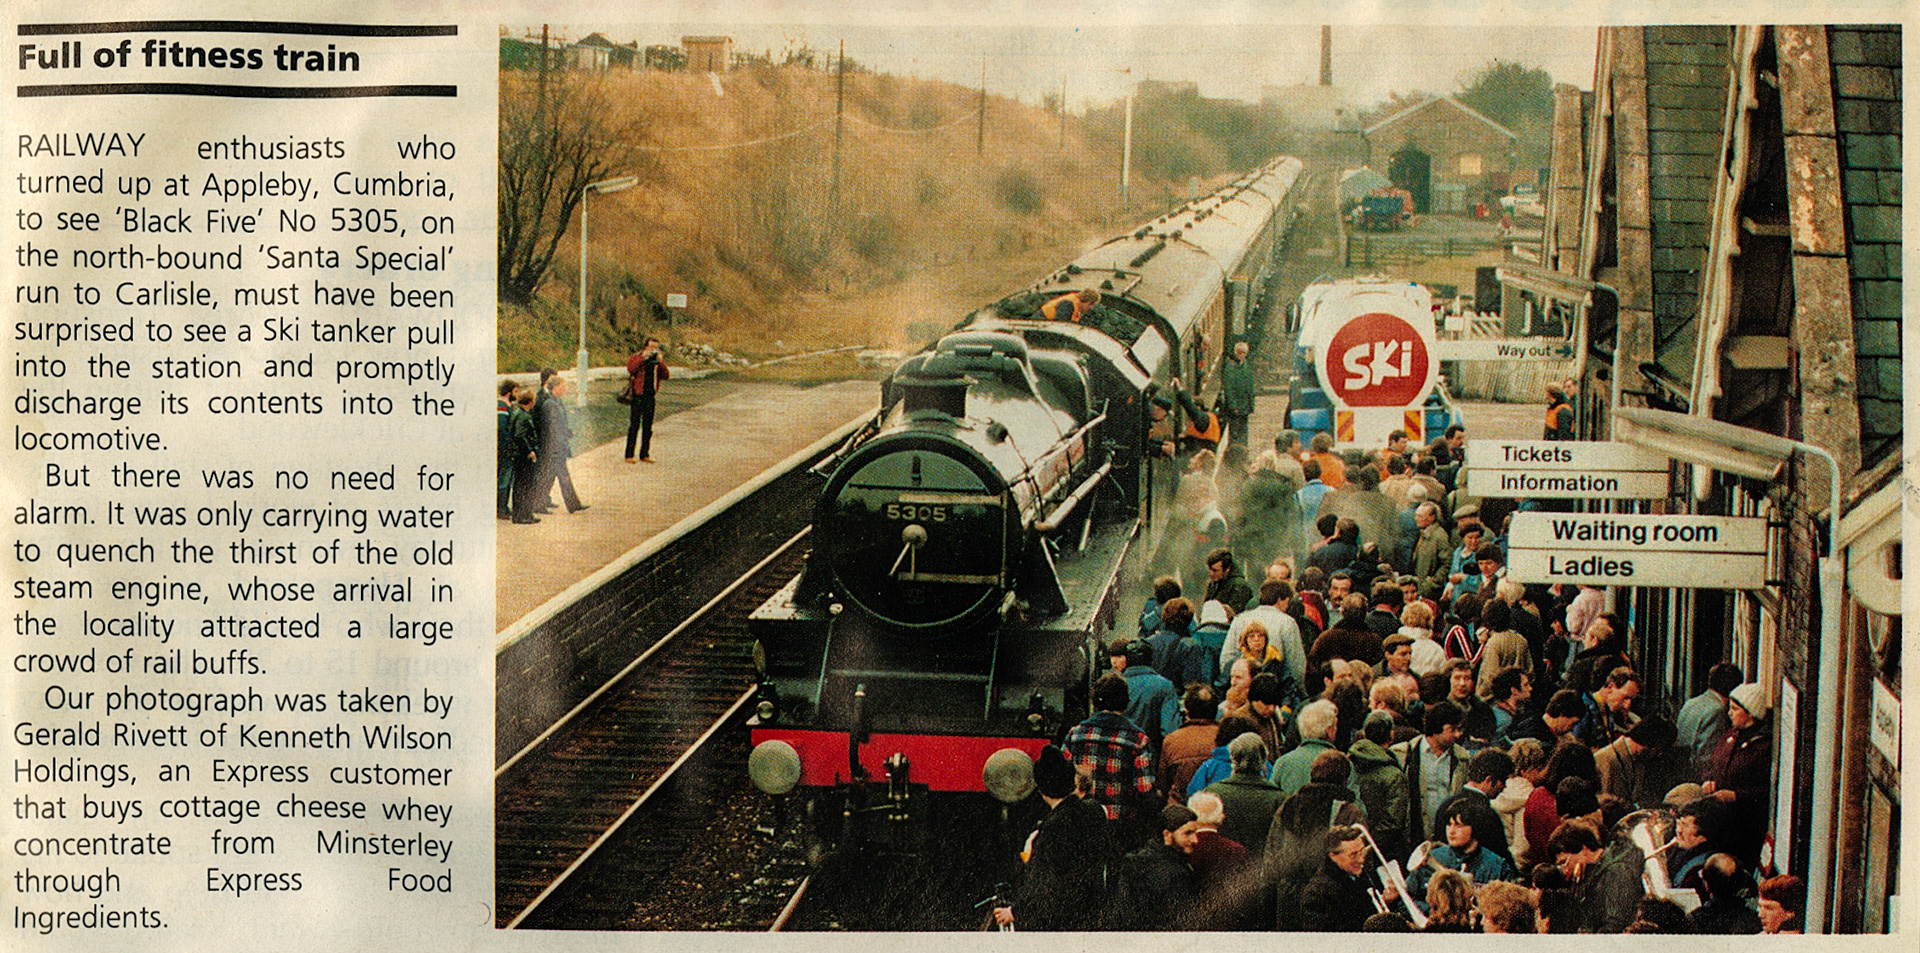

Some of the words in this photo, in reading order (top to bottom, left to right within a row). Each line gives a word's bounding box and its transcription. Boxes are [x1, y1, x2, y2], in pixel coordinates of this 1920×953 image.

[19, 41, 81, 69] Full
[94, 40, 131, 68] of
[142, 40, 263, 69] fitness
[274, 44, 359, 71] train
[19, 133, 145, 157] RAILWAY
[198, 135, 344, 159] enthusiasts
[398, 134, 455, 160] who
[17, 168, 103, 194] turned
[119, 177, 150, 201] up
[165, 174, 189, 196] at
[202, 171, 318, 202] Appleby,
[334, 171, 453, 201] Cumbria,
[17, 210, 42, 230] to
[58, 212, 99, 231] see
[116, 207, 192, 232] 'Black
[208, 208, 262, 233] Five'
[281, 209, 315, 232] No
[332, 208, 405, 237] 5305,
[422, 216, 453, 234] on
[16, 242, 58, 266] the
[74, 244, 241, 269] north-bound
[259, 245, 339, 269] 'Santa
[356, 246, 453, 276] Special'
[17, 286, 58, 303] run
[74, 283, 100, 305] to
[117, 281, 217, 309] Carlisle,
[235, 284, 299, 305] must
[315, 280, 374, 306] have
[391, 282, 453, 308] been
[15, 317, 133, 347] surprised
[146, 320, 172, 341] to
[184, 325, 226, 342] see
[238, 325, 250, 341] a
[264, 317, 299, 341] Ski
[311, 318, 396, 343] tanker
[409, 320, 453, 350] pull
[1497, 344, 1525, 358] Way
[1529, 345, 1551, 357] out
[16, 352, 66, 377] into
[88, 353, 130, 378] the
[153, 354, 240, 378] station
[264, 353, 312, 377] and
[337, 356, 454, 386] promptly
[15, 389, 141, 420] discharge
[162, 391, 188, 414] its
[209, 392, 322, 414] contents
[343, 390, 392, 415] into
[412, 391, 454, 416] the
[16, 425, 167, 450] locomotive.
[1501, 445, 1572, 462] Tickets
[47, 464, 90, 486] But
[112, 462, 180, 487] there
[202, 470, 253, 488] was
[277, 471, 308, 489] no
[332, 464, 394, 490] need
[417, 465, 454, 491] for
[1501, 474, 1618, 491] Information
[15, 499, 94, 524] alarm.
[109, 501, 124, 524] It
[135, 507, 186, 525] was
[198, 500, 252, 533] only
[263, 502, 366, 534] carrying
[378, 506, 454, 528] water
[887, 504, 946, 522] 5305
[1552, 519, 1647, 545] Waiting
[1653, 524, 1718, 542] room
[14, 540, 40, 562] to
[57, 537, 153, 568] quench
[171, 538, 213, 563] the
[229, 538, 296, 564] thirst
[313, 539, 340, 564] of
[355, 539, 397, 564] the
[414, 540, 452, 565] old
[1549, 556, 1634, 577] Ladies
[14, 577, 91, 598] steam
[112, 575, 208, 606] engine,
[228, 576, 314, 601] whose
[333, 577, 411, 602] arrival
[432, 578, 452, 602] in
[14, 610, 56, 635] the
[84, 610, 174, 643] locality
[201, 613, 319, 638] attracted
[348, 621, 360, 638] a
[390, 614, 453, 646] large
[14, 648, 95, 672] crowd
[107, 648, 133, 673] of
[144, 649, 180, 674] rail
[193, 649, 265, 674] buffs.
[45, 686, 94, 709] Our
[107, 685, 262, 717] photograph
[275, 694, 326, 712] was
[338, 687, 410, 712] taken
[424, 688, 453, 719] by
[15, 721, 99, 746] Gerald
[115, 722, 187, 746] Rivett
[200, 723, 227, 747] of
[241, 724, 350, 748] Kenneth
[363, 724, 451, 749] Wilson
[15, 757, 136, 788] Holdings,
[159, 765, 189, 781] an
[214, 760, 308, 788] Express
[330, 764, 452, 786] customer
[14, 795, 66, 818] that
[84, 794, 142, 824] buys
[160, 796, 260, 824] cottage
[277, 793, 366, 819] cheese
[382, 797, 452, 828] whey
[15, 833, 170, 855] concentrate
[212, 829, 274, 854] from
[318, 830, 452, 863] Minsterley
[14, 867, 119, 898] through
[208, 868, 302, 897] Express
[389, 868, 451, 892] Food
[15, 904, 167, 934] Ingredients.
